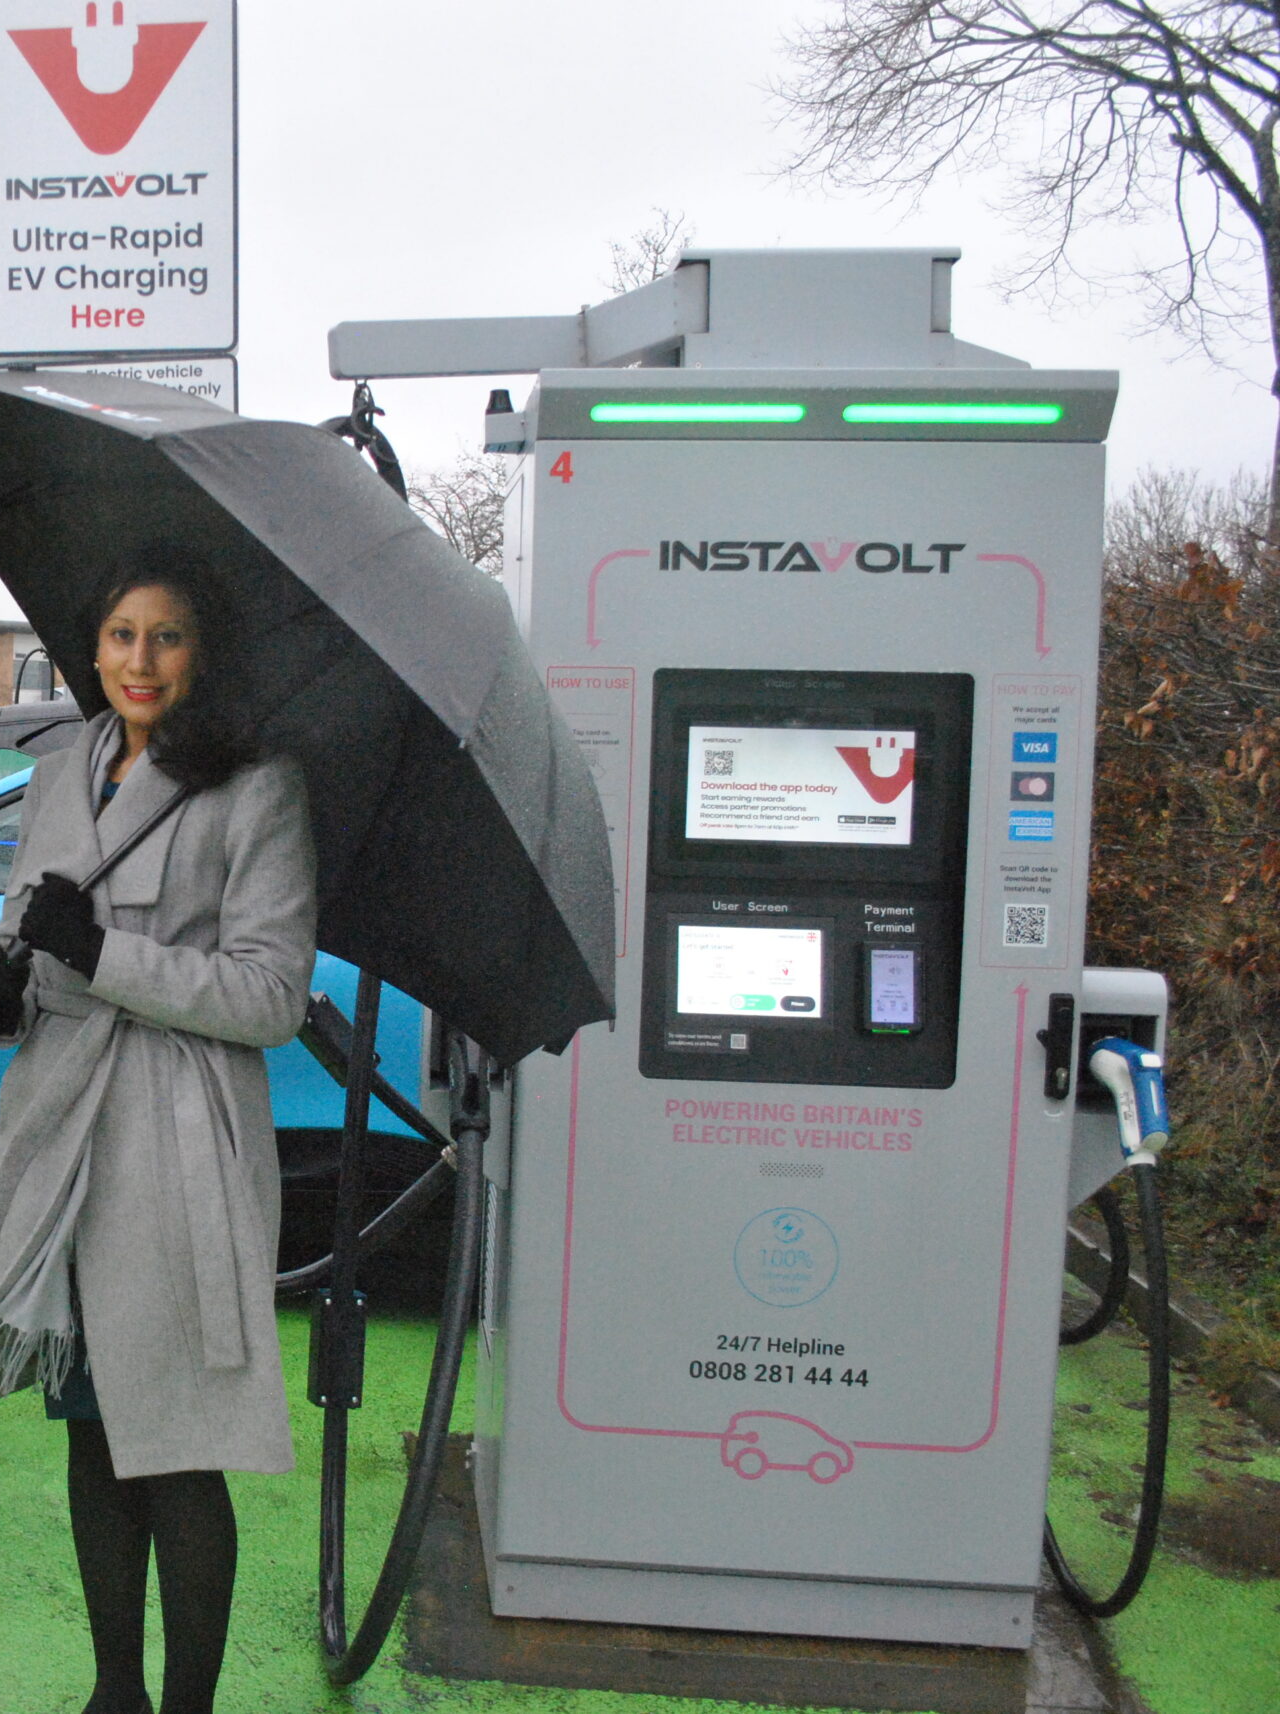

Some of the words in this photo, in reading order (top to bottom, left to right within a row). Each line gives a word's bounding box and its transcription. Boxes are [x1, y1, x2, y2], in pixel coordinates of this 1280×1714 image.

[5, 172, 209, 201] INSTAVOLT
[12, 221, 203, 257] Ultra-Rapid
[8, 266, 46, 291] EV
[54, 261, 208, 296] Charging
[71, 305, 145, 329] Here
[146, 364, 203, 379] vehicle
[187, 382, 222, 399] only
[549, 450, 574, 484] 4
[658, 537, 967, 575] INSTAVOLT
[551, 677, 581, 689] HOW
[585, 678, 601, 689] TO
[605, 678, 629, 689] USE
[997, 684, 1027, 696] HOW
[1032, 684, 1049, 696] TO
[1053, 685, 1078, 697] PAY
[1022, 742, 1049, 753] VISA
[700, 781, 757, 791] Download
[759, 782, 778, 791] the
[779, 784, 803, 794] app
[804, 783, 838, 795] today
[720, 795, 752, 803] earning
[760, 804, 807, 812] promotions
[699, 812, 752, 820] Recommend
[759, 812, 783, 821] friend
[784, 813, 800, 821] and
[1000, 864, 1017, 872] Scan
[1031, 865, 1049, 873] code
[712, 900, 739, 911] User
[747, 902, 788, 912] Screen
[864, 904, 915, 917] Payment
[864, 921, 915, 933] Terminal
[664, 1098, 796, 1122] POWERING
[803, 1104, 924, 1128] BRITAIN'S
[672, 1123, 787, 1147] ELECTRIC
[794, 1129, 913, 1152] VEHICLES
[760, 1248, 814, 1270] 100%
[716, 1334, 762, 1352] 24/7
[767, 1337, 846, 1358] Helpline
[689, 1360, 747, 1381] 0808
[753, 1363, 794, 1383] 281
[804, 1366, 833, 1385] 44
[840, 1368, 869, 1387] 44
